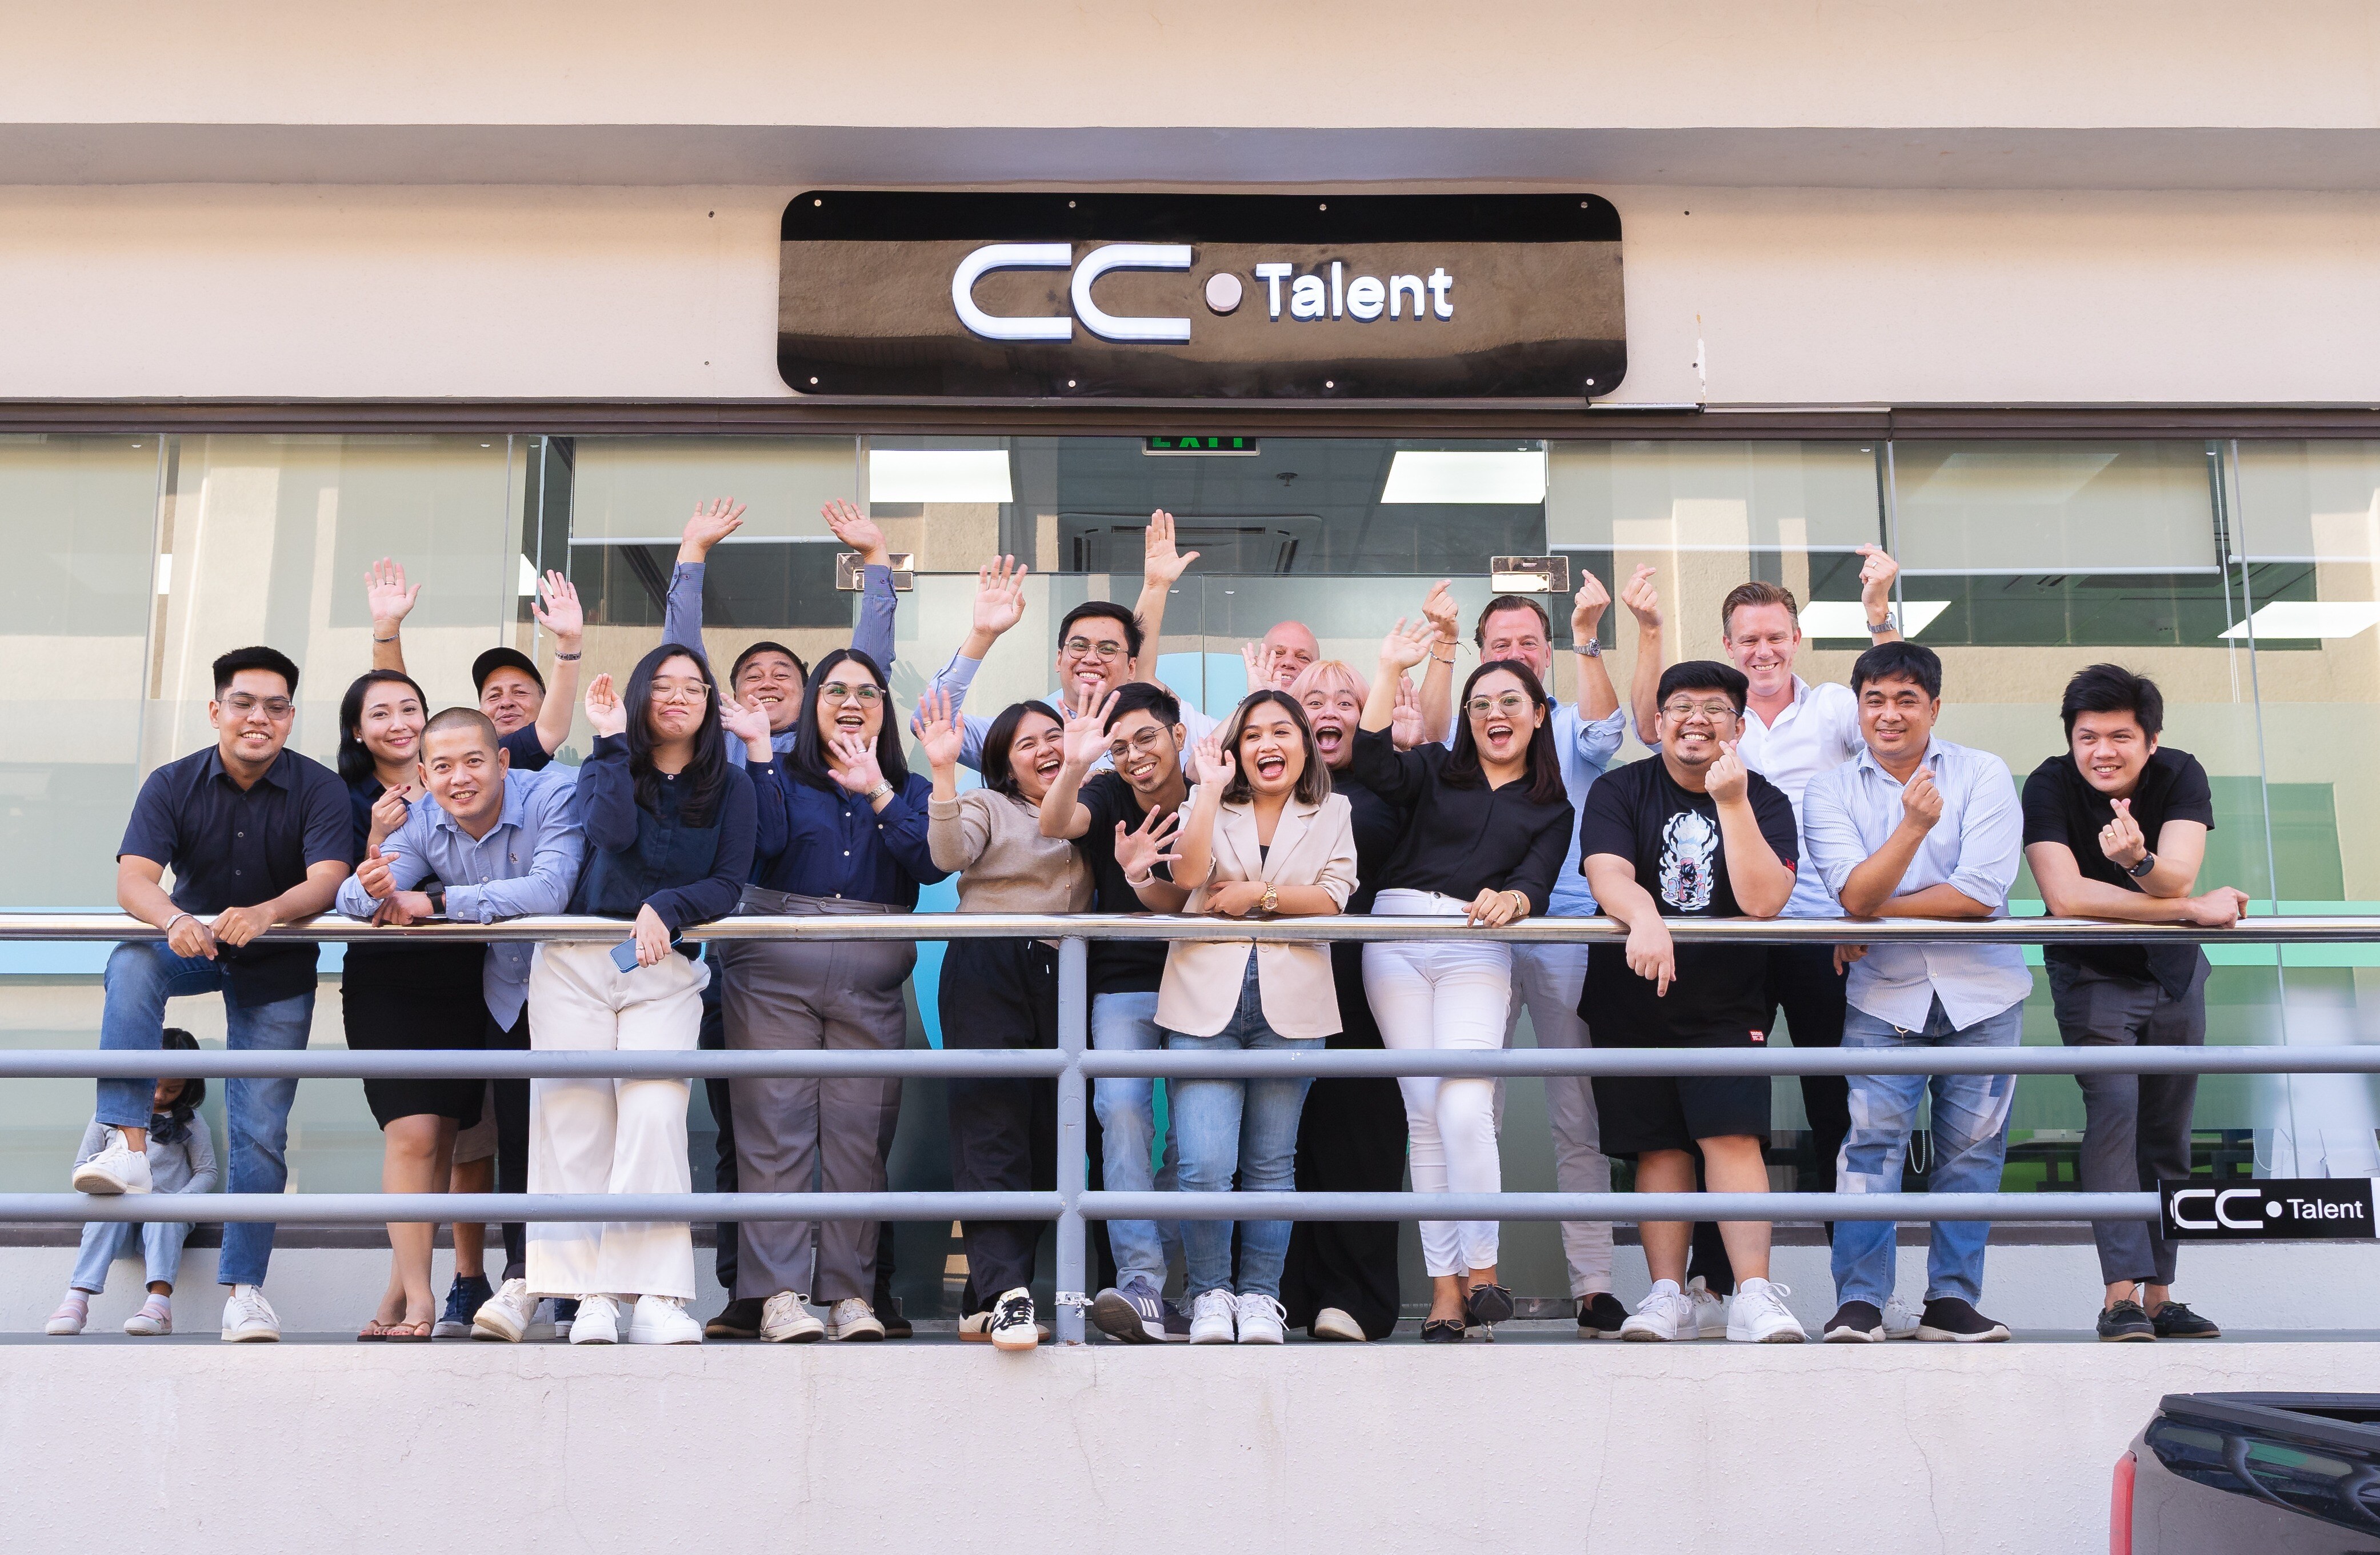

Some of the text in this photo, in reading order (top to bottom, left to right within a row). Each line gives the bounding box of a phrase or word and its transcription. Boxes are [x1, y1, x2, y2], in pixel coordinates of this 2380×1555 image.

[951, 243, 1454, 342] CC Talent
[2170, 1189, 2364, 1229] CC Talent
